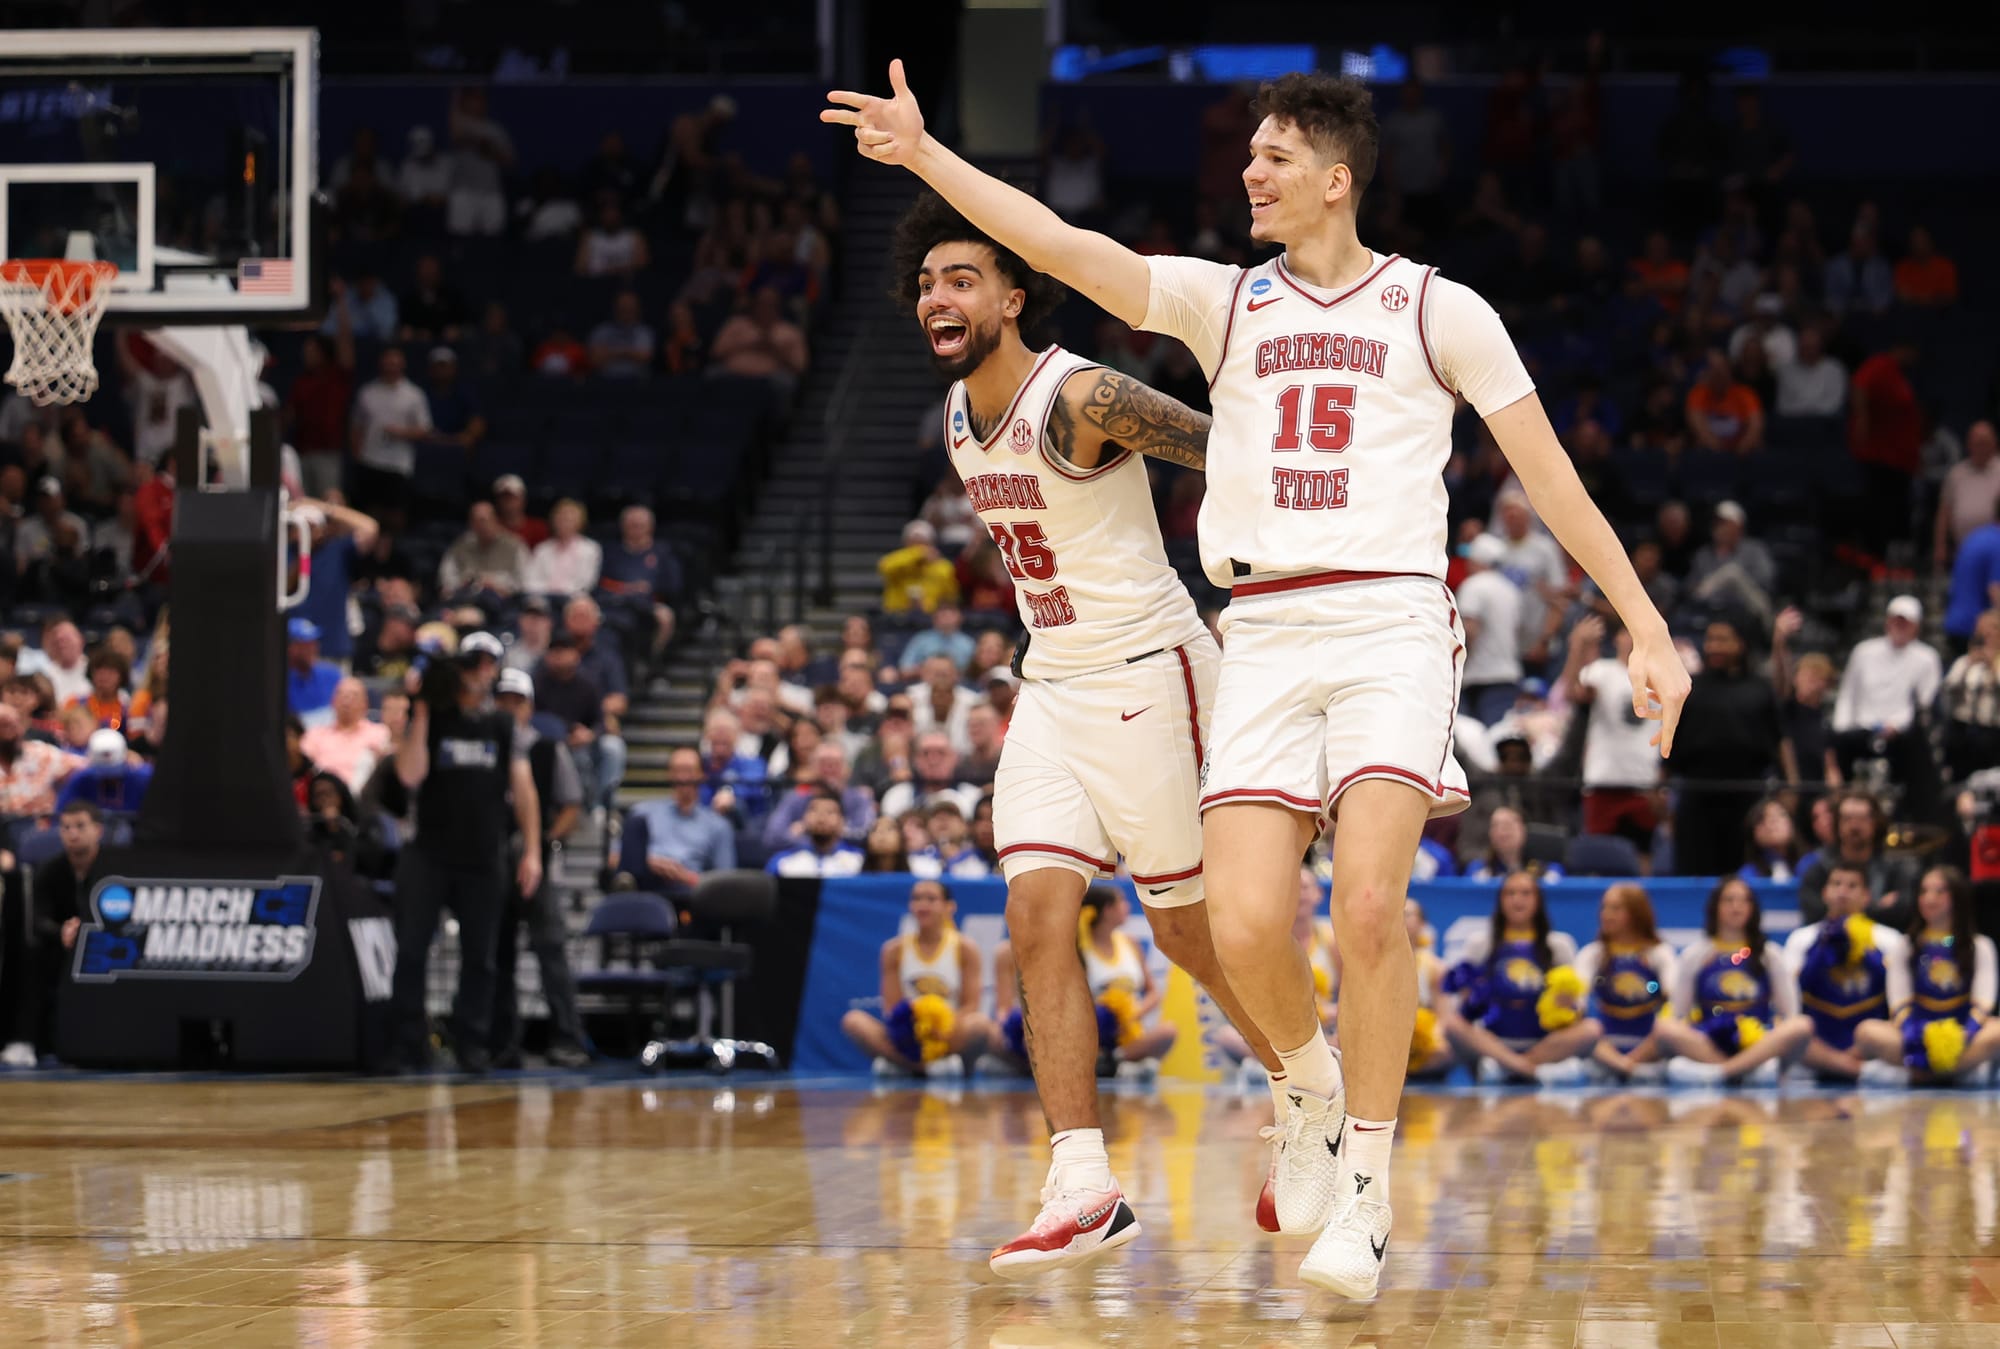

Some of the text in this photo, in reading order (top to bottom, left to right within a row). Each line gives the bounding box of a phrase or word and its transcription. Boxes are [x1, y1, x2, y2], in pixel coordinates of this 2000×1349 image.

[1382, 285, 1408, 310] SEC
[1256, 333, 1388, 378] CRIMSON
[1272, 384, 1357, 453] 15
[965, 474, 1047, 513] RIMSON
[1272, 466, 1349, 510] TIDE
[131, 886, 255, 924] MARCH
[144, 924, 308, 964] MADNESS
